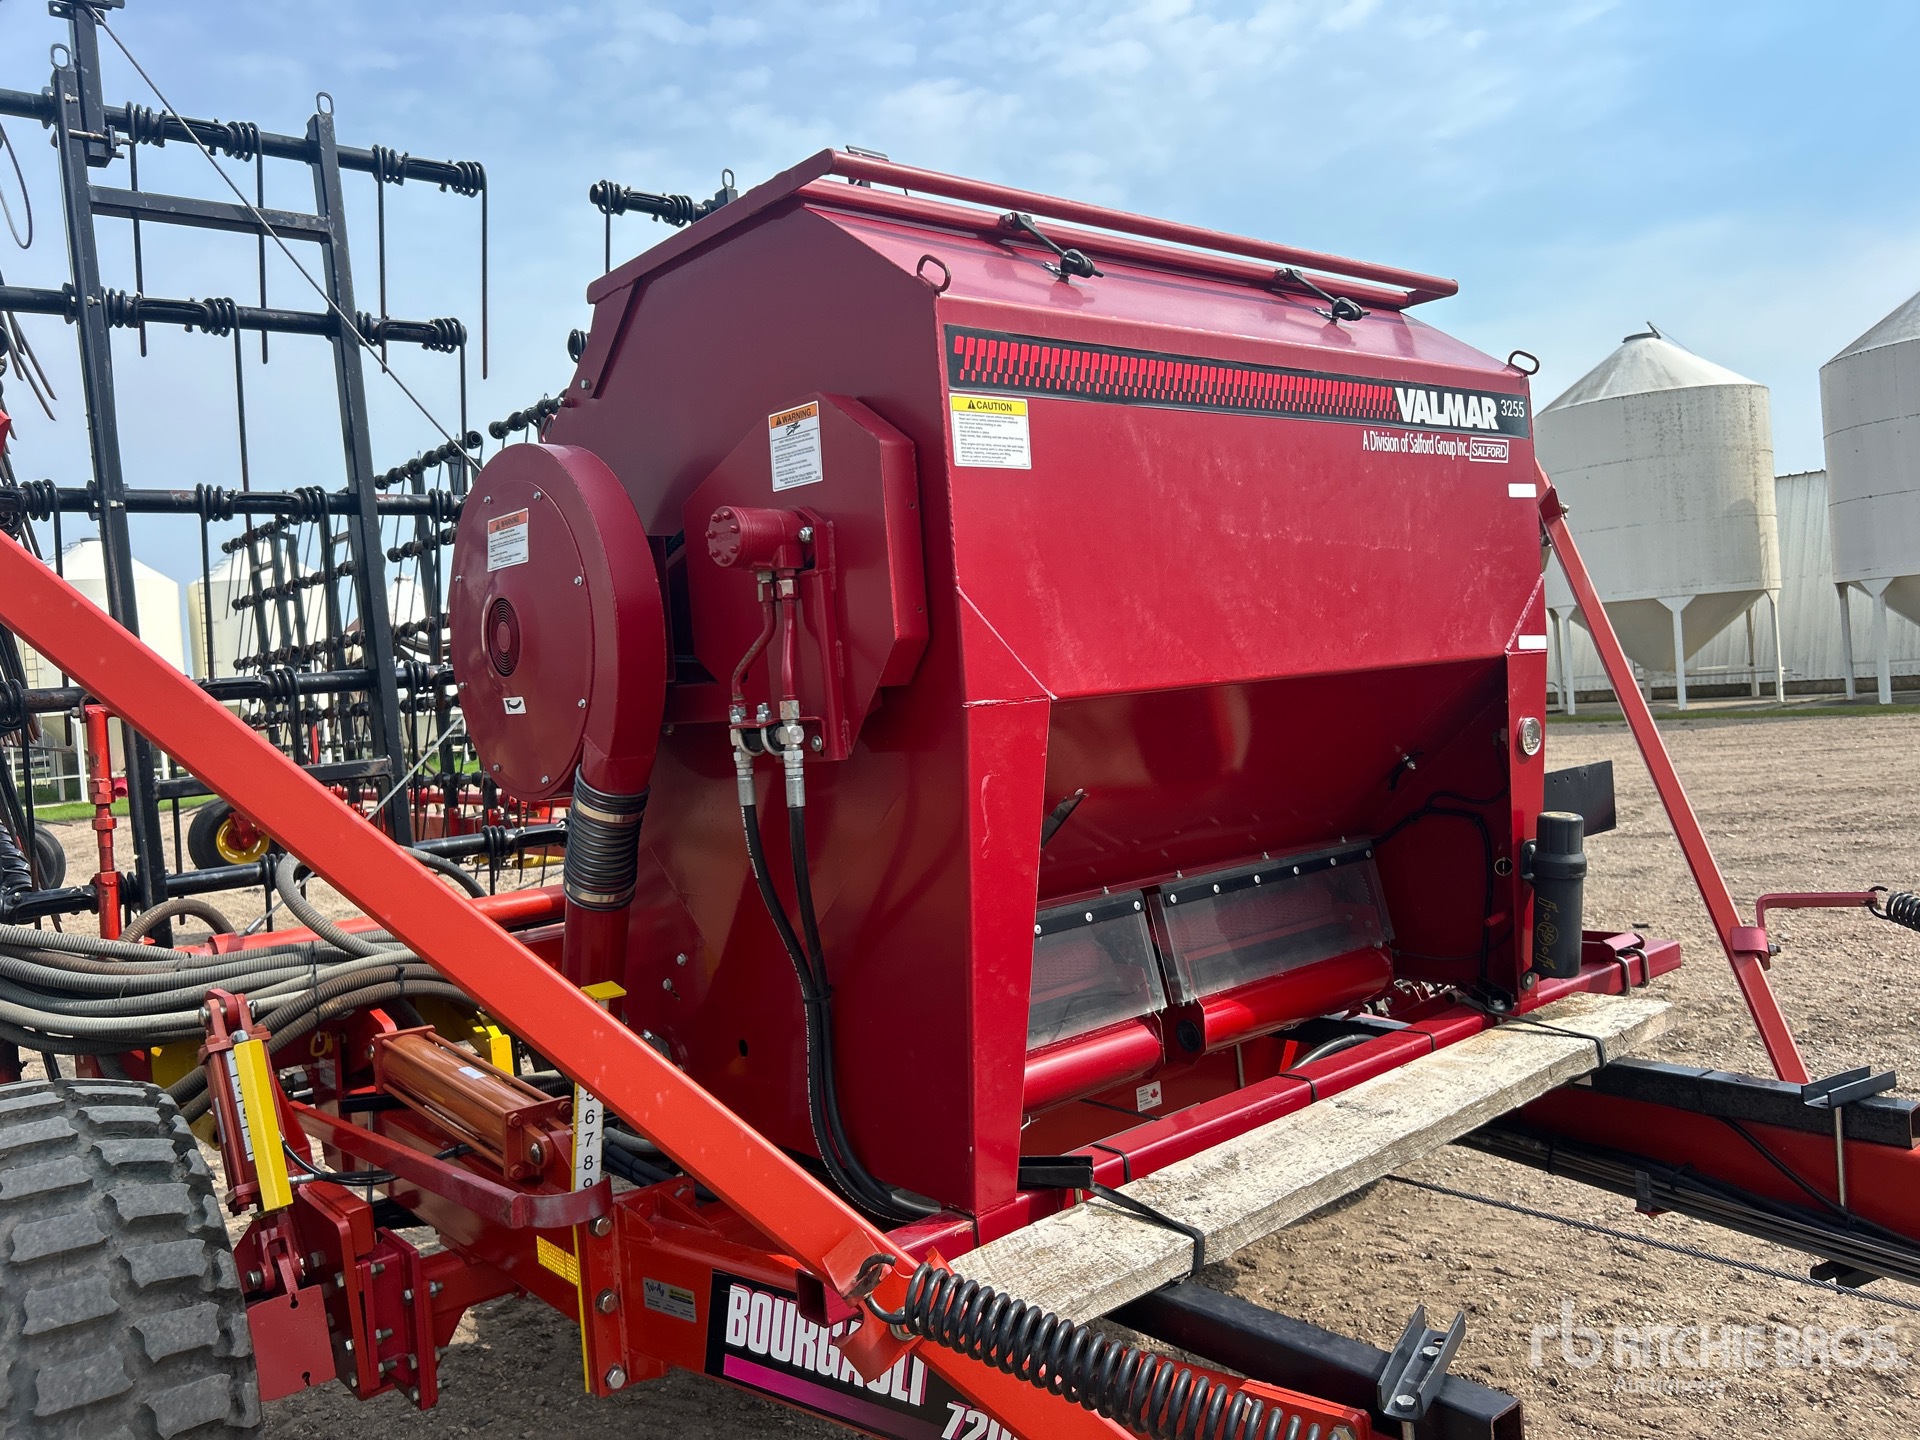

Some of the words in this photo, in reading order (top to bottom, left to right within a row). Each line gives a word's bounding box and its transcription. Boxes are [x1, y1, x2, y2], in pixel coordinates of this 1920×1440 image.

[976, 401, 1012, 412] CAUTION
[1395, 387, 1499, 430] VALMAR
[1500, 399, 1525, 418] 3255
[782, 408, 812, 424] WARNING
[1363, 430, 1370, 451] A
[1370, 430, 1399, 453] Division
[1401, 432, 1408, 453] of
[1410, 433, 1434, 455] Salford
[1435, 435, 1456, 460] Group
[1457, 437, 1469, 457] Inc.
[1471, 442, 1507, 458] SALFORD
[585, 1109, 595, 1124] 6
[584, 1131, 594, 1147] 7
[583, 1155, 593, 1170] 8
